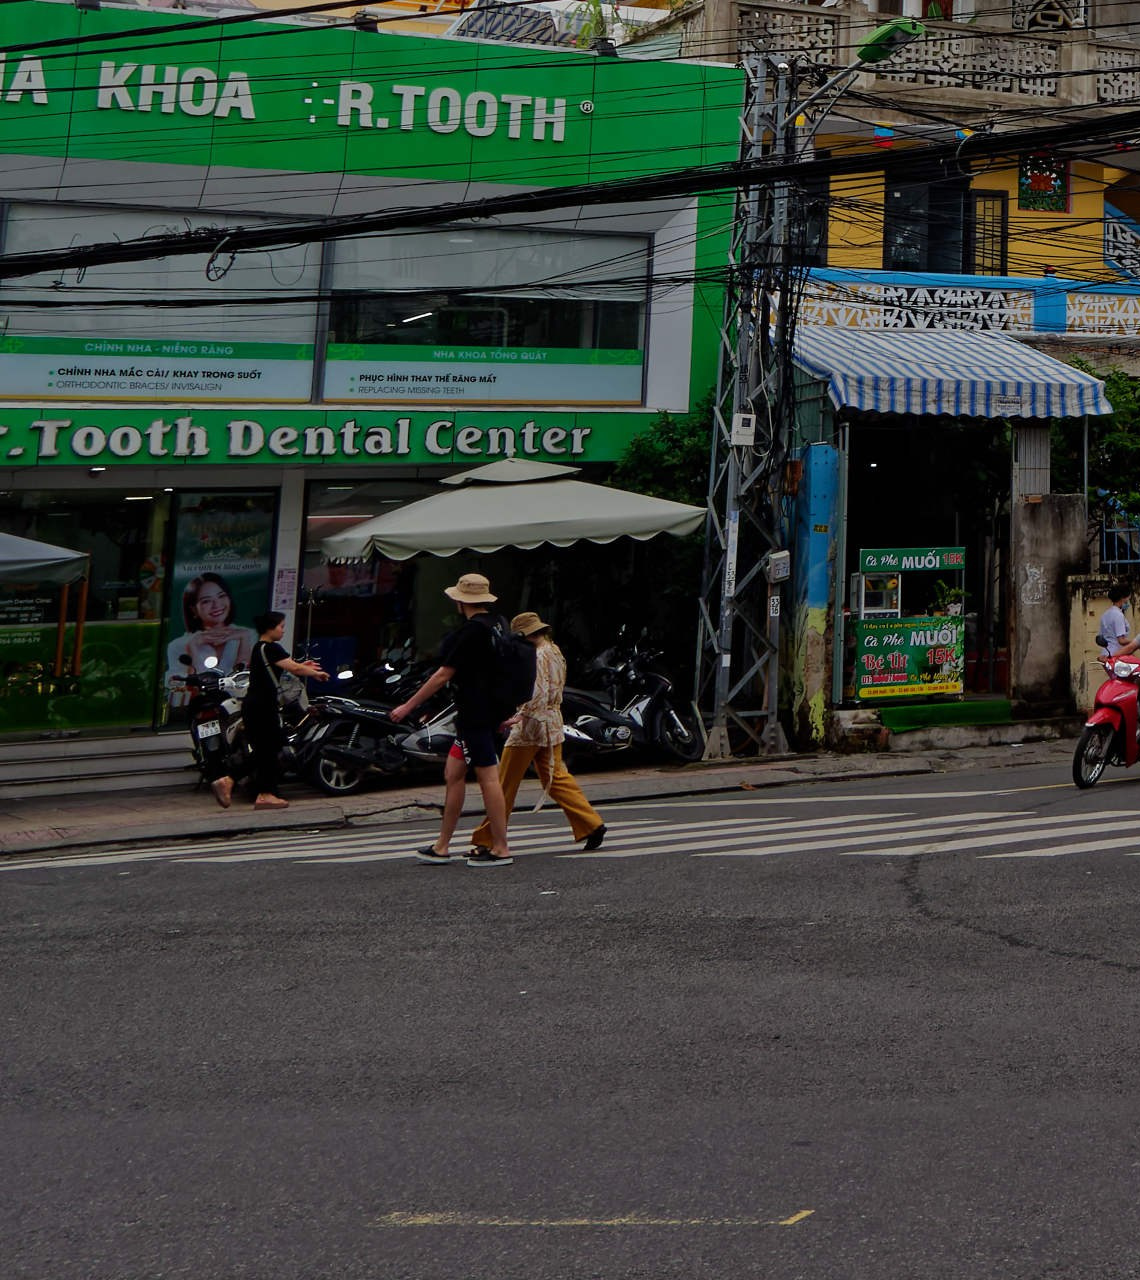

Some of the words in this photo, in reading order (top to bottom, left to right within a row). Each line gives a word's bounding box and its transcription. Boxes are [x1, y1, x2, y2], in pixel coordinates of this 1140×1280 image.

[0, 53, 49, 104] A
[97, 61, 256, 120] KHOA
[127, 343, 152, 353] NHA
[433, 350, 455, 360] NHA
[458, 351, 487, 360] KHOA
[94, 368, 117, 377] NHA
[172, 369, 199, 379] KHAY
[201, 371, 235, 380] TRONG
[411, 374, 434, 384] THAY
[56, 380, 127, 390] ORTHODONTIC
[171, 382, 223, 392] INVISALIGN
[358, 385, 405, 394] REPLACING
[407, 385, 441, 394] MISSING
[442, 386, 465, 395] TEETH
[227, 418, 411, 457] Dental
[425, 420, 592, 456] Center
[901, 550, 940, 569] MUỐI
[943, 553, 963, 565] 15K
[910, 624, 957, 647] MUỐI
[926, 648, 956, 666] 15K
